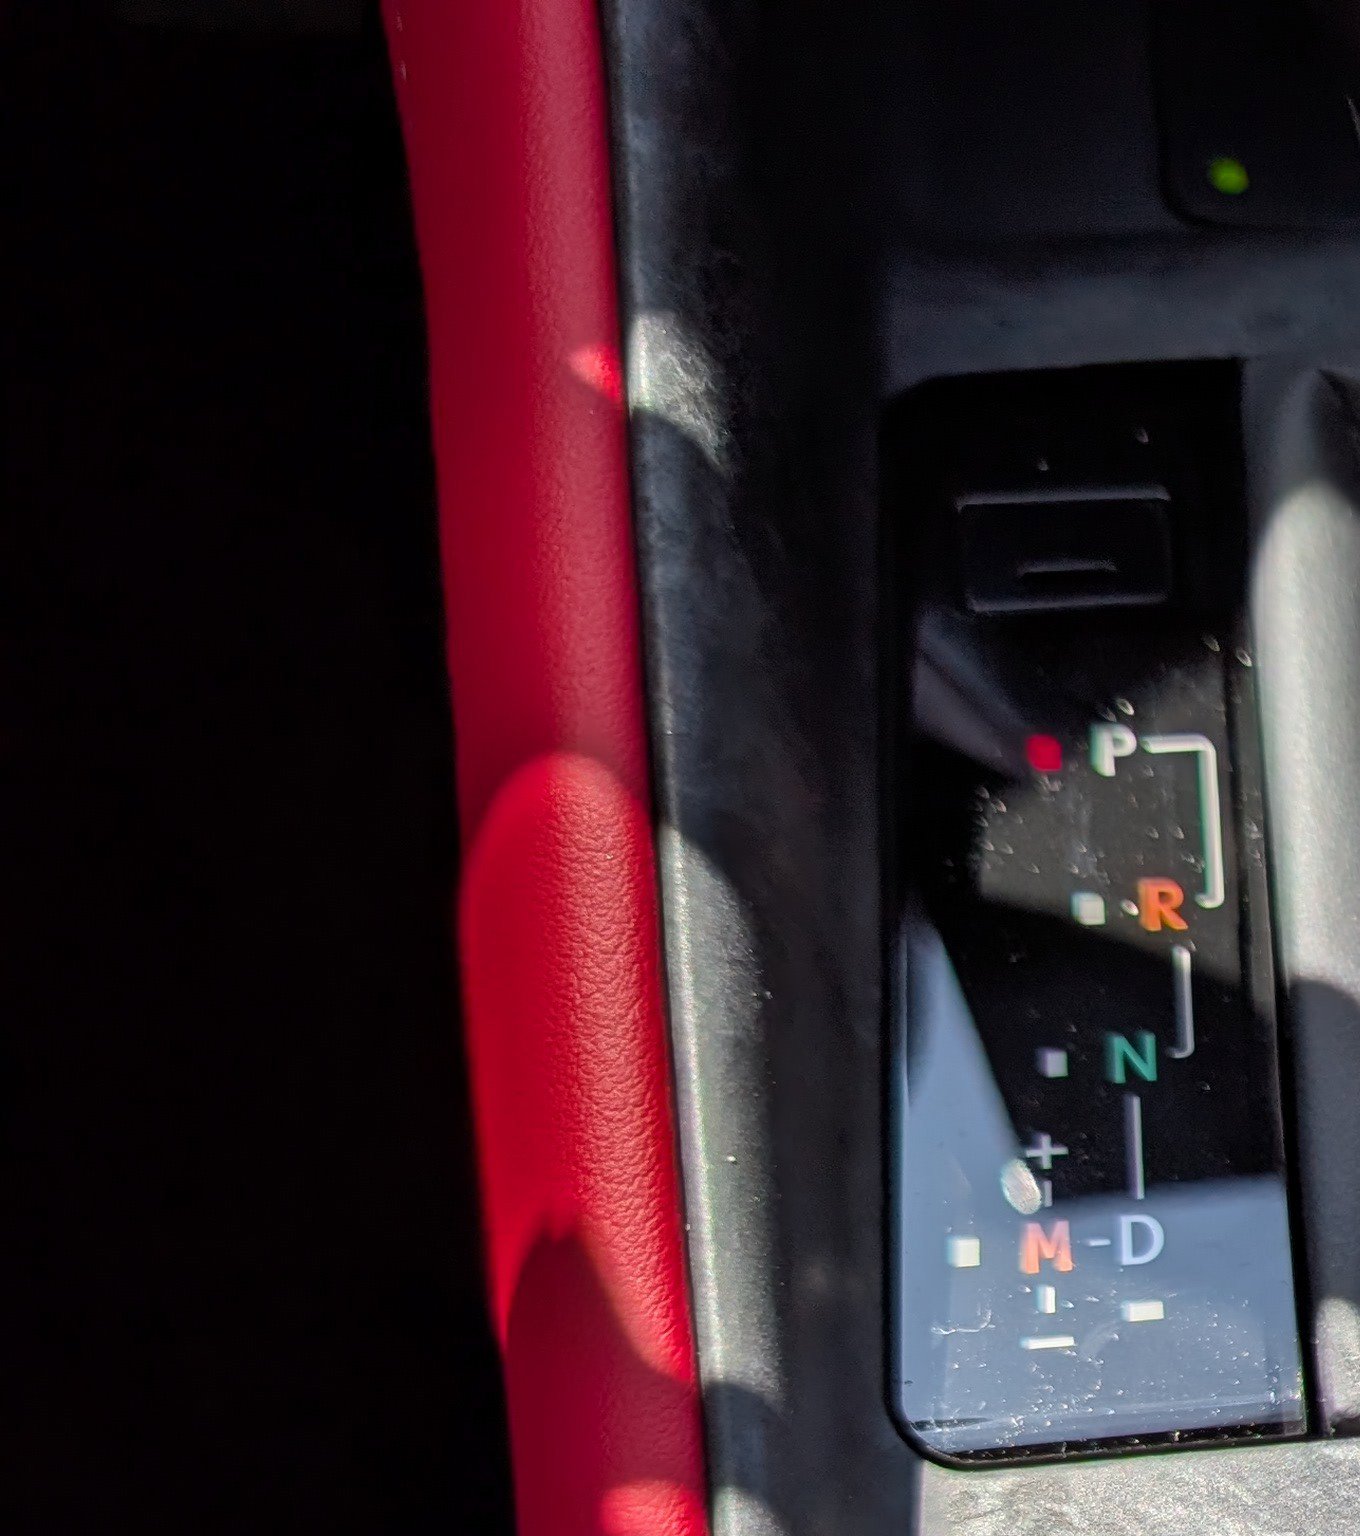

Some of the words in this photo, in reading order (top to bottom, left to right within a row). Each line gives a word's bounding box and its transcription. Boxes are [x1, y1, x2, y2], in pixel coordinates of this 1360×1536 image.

[1091, 723, 1137, 776] P
[1138, 877, 1189, 931] R
[1111, 1031, 1158, 1083] N
[1019, 1219, 1073, 1273] M
[1115, 1213, 1165, 1266] D
